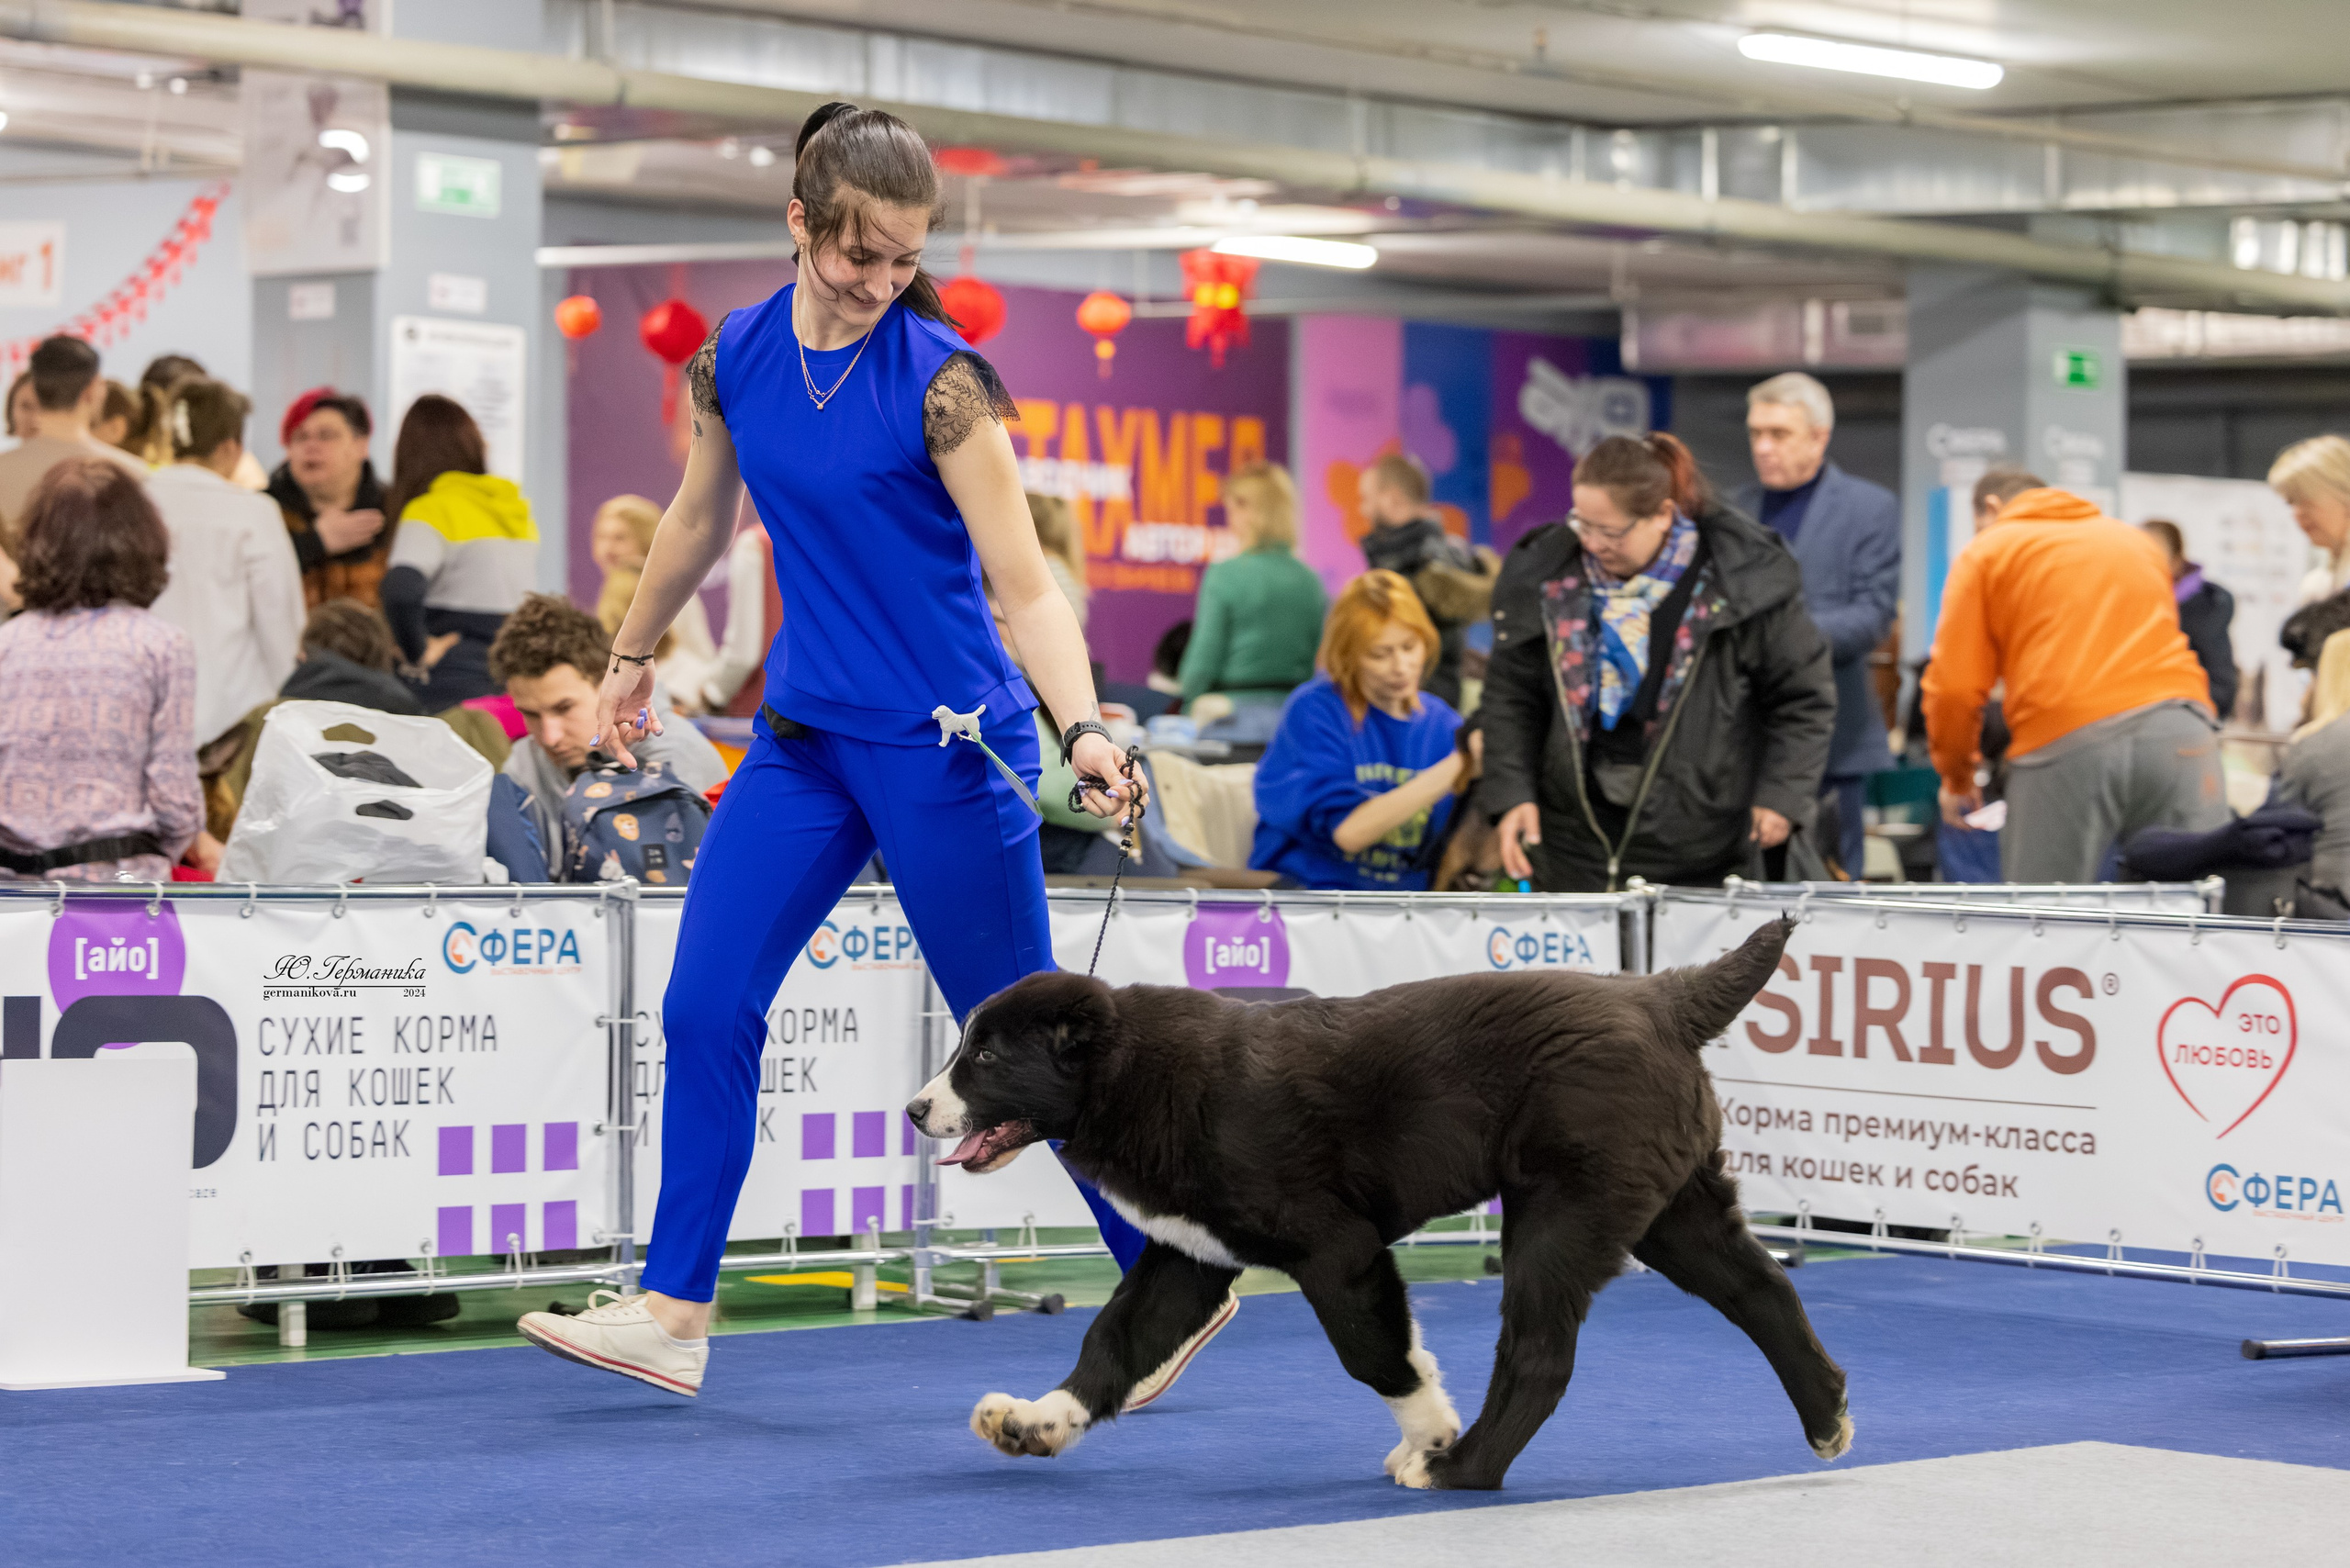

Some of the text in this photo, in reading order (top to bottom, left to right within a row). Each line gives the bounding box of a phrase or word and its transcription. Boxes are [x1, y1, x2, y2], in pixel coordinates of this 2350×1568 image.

[442, 921, 582, 974] СФЕРА
[806, 920, 922, 969] СФЕР
[1487, 926, 1595, 969] СФЕРА
[259, 1014, 498, 1057] СУХИЕ КОРМА
[2238, 1013, 2281, 1035] ЭТО
[759, 1057, 818, 1093] ШЕК
[2174, 1044, 2273, 1070] ЛЮБОВЬ
[257, 1066, 455, 1117] ДЛЯ КОШЕК
[258, 1119, 410, 1162] И СОБАК
[1824, 1112, 2097, 1155] премиум-класса
[1782, 1154, 1885, 1187] кошек
[1895, 1166, 1913, 1189] и
[1926, 1164, 2019, 1197] собак
[2205, 1163, 2344, 1214] СФЕРА
